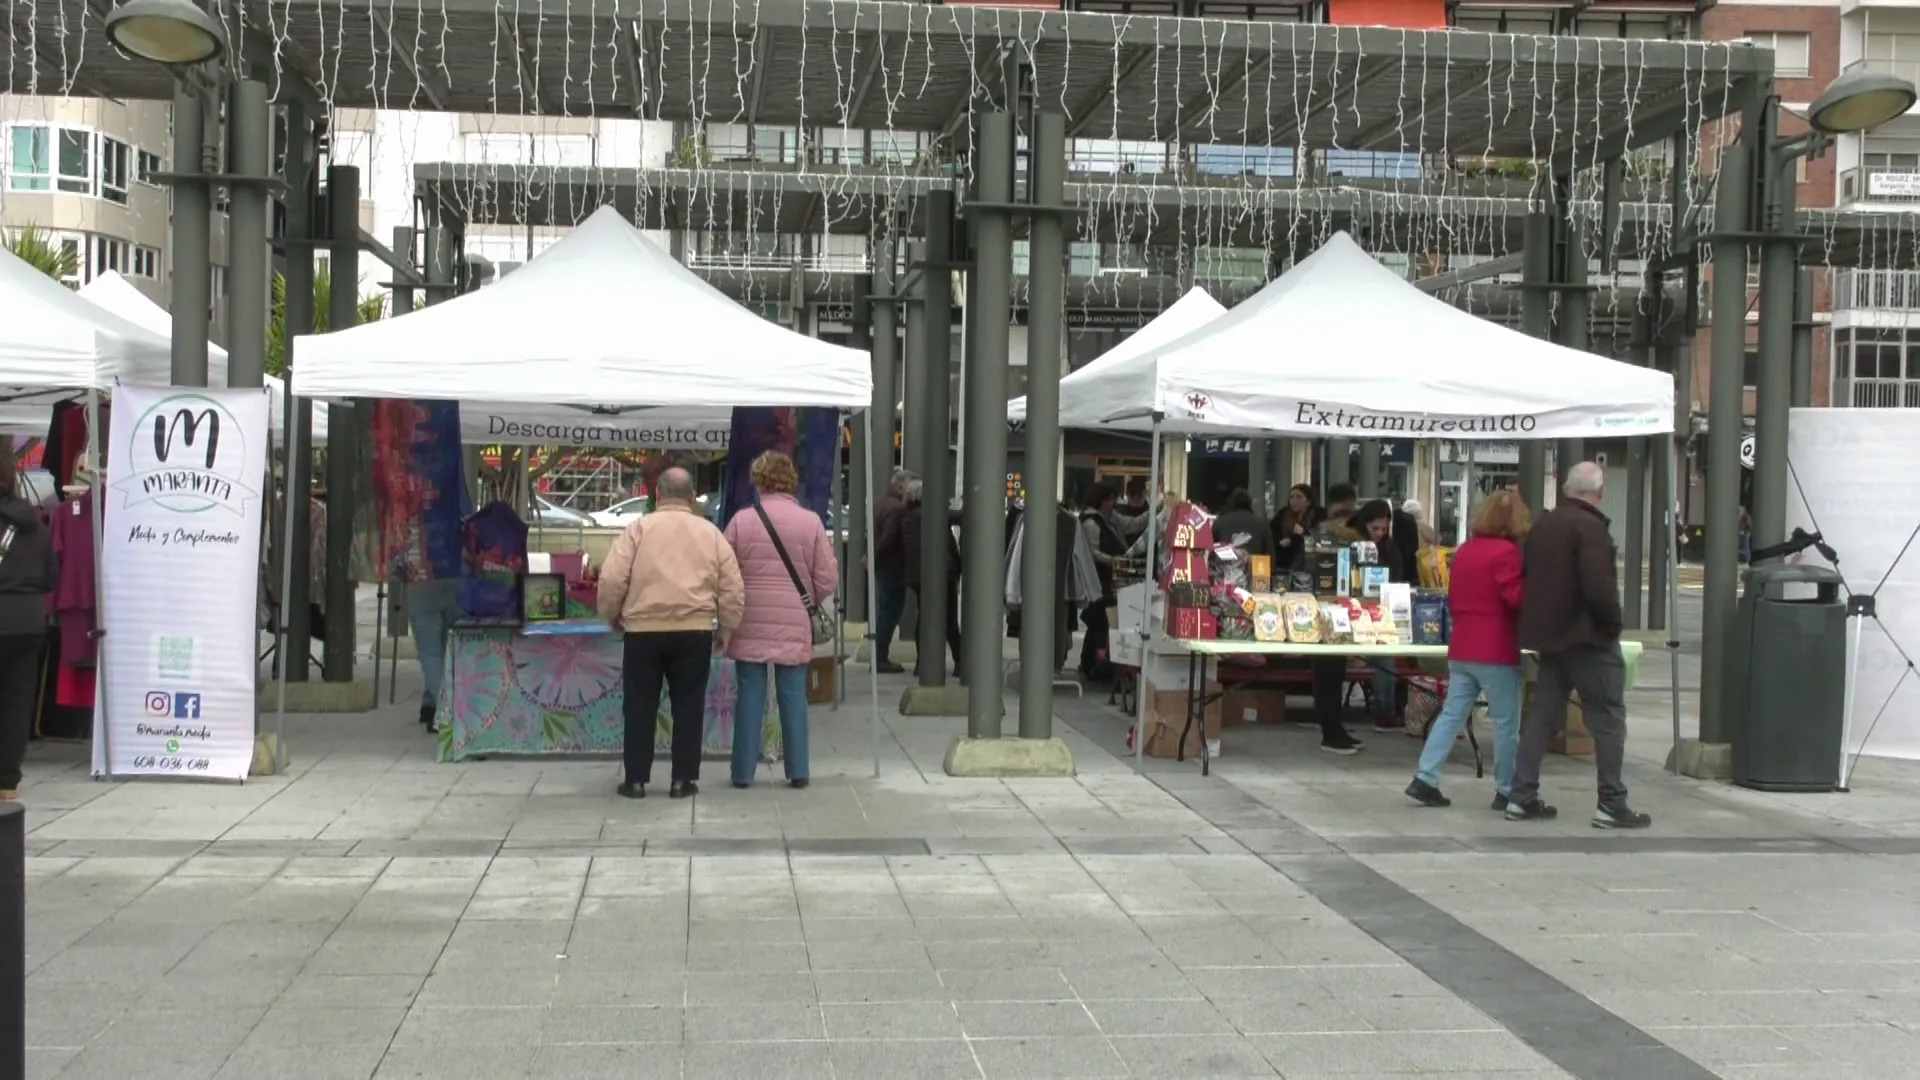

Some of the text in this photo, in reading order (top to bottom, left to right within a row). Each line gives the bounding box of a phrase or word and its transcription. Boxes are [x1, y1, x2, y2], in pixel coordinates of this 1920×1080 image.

[488, 415, 730, 449] Descarga nuestra ap
[1295, 401, 1536, 433] Extramureando
[154, 408, 219, 469] M
[143, 470, 231, 501] MARANTA
[162, 531, 170, 546] y
[134, 756, 155, 768] 608
[160, 757, 182, 770] 036
